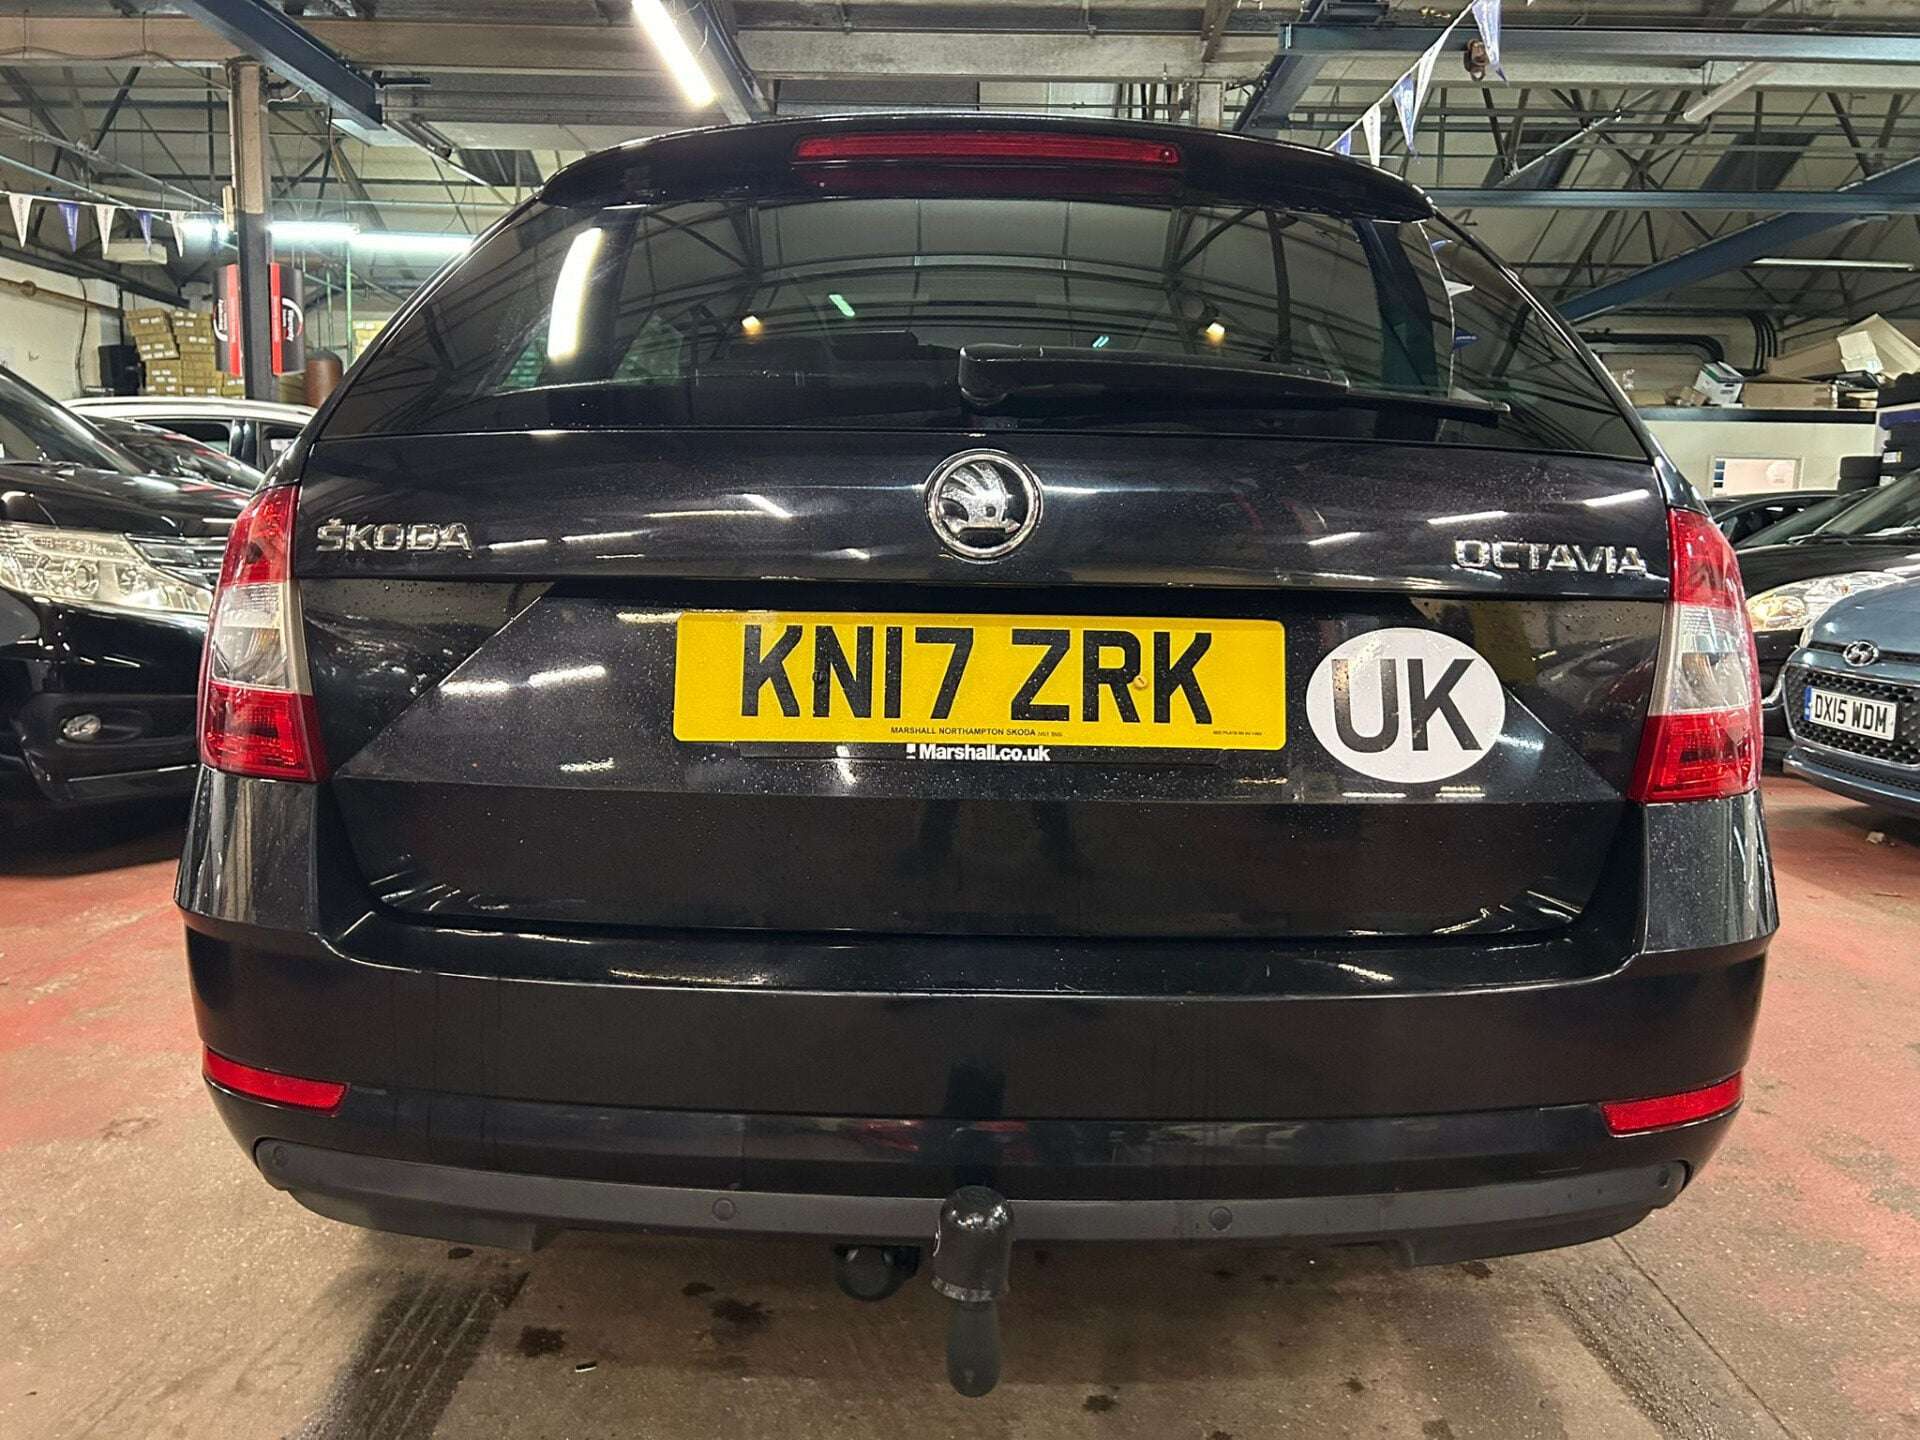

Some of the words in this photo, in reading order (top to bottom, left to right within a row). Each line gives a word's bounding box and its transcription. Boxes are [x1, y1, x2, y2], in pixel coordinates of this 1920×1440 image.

[316, 518, 472, 551] ŠKODA
[1455, 539, 1647, 576] OCTAVIA
[741, 624, 974, 720] KN17
[1010, 628, 1213, 725] ZRK
[1331, 658, 1483, 754] UK
[1814, 693, 1848, 725] DX15
[1851, 700, 1888, 734] WDM
[890, 726, 936, 735] MARSHALL
[938, 727, 1004, 736] NORTHAMPTON
[1006, 728, 1036, 737] SKODA
[918, 743, 1051, 762] Marshall.co.uk
